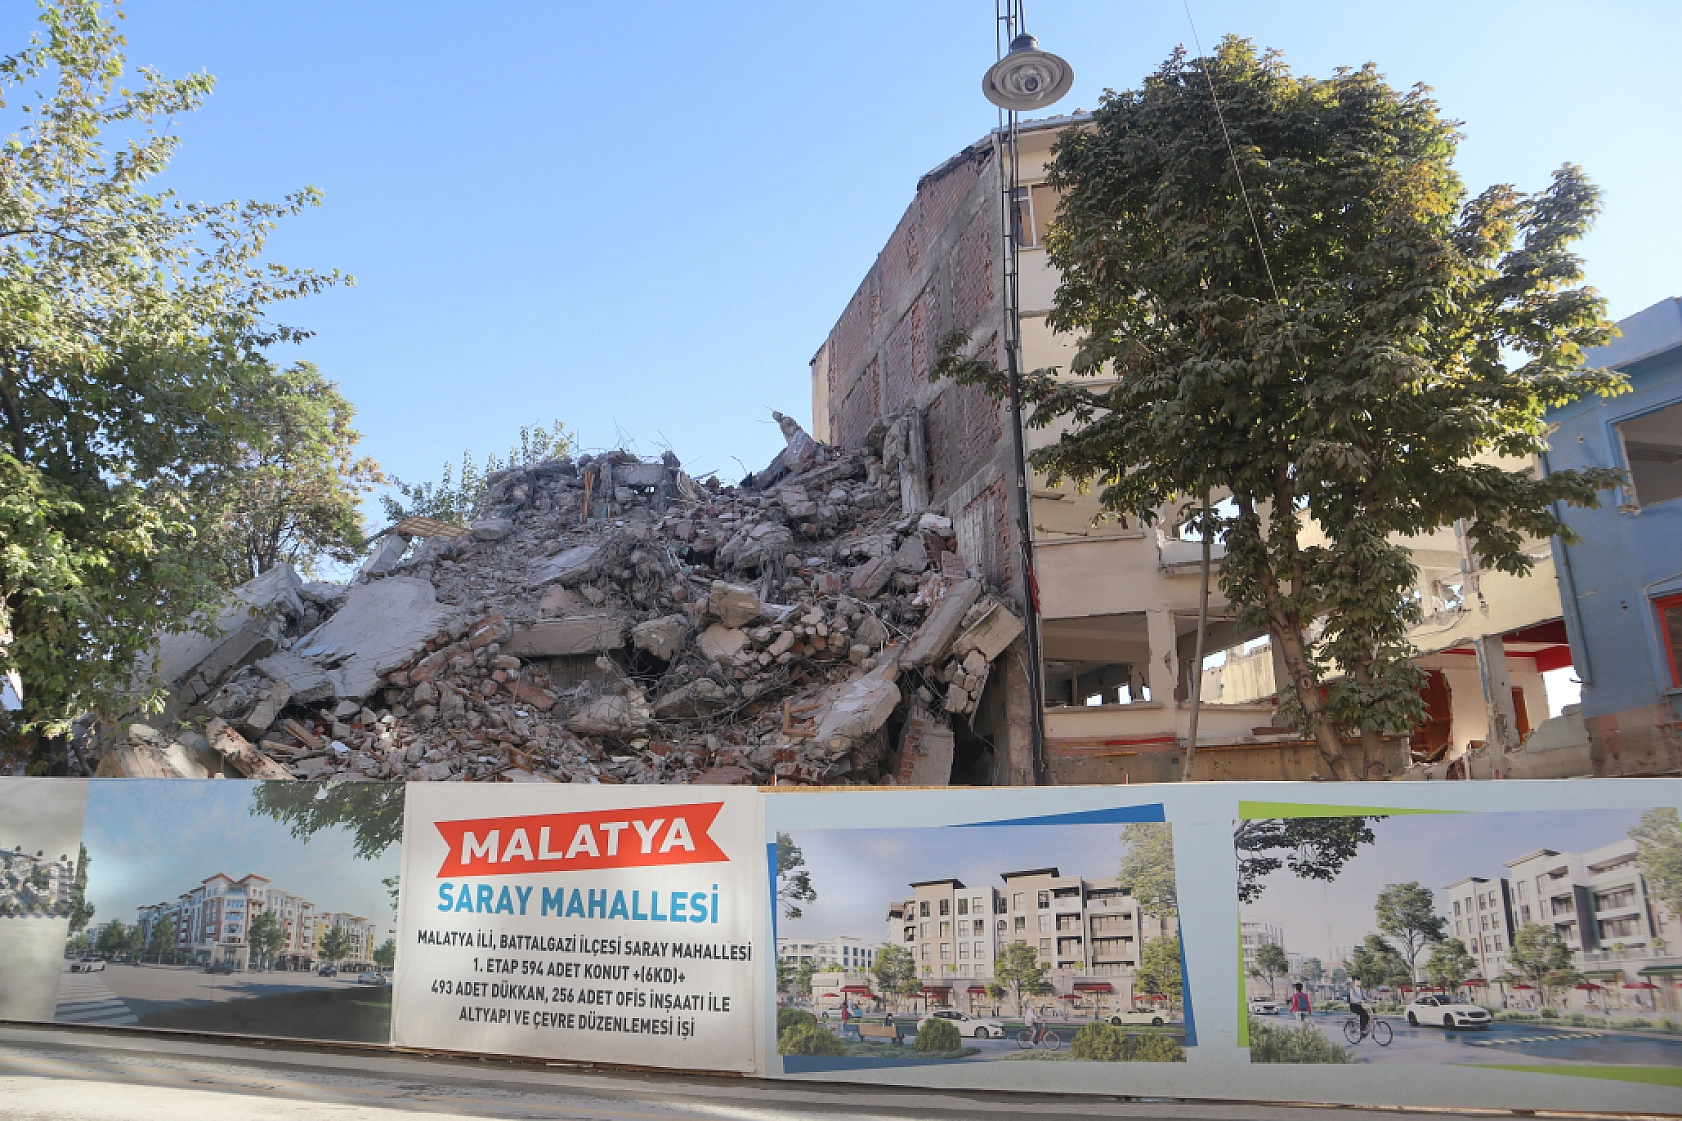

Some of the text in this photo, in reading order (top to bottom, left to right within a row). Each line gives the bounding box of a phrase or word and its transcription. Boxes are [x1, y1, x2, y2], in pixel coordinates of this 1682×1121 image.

[460, 817, 696, 865] MALATYA
[437, 883, 719, 924] SARAY MAHALLESİ
[417, 929, 751, 962] MALATYA İLİ, BATTALGAZİ İLÇESİ SARAY MAHALLESİ
[473, 957, 686, 985] 1. ETAP 594 ADET KONUT +(6KD)+
[431, 979, 730, 1014] 493 ADET DÜKKAN, 256 ADET OFİS İNŞAATI İLE
[459, 1007, 695, 1040] ALTYAPI VE ÇEVRE DÜZENLEMESİ İŞİ
